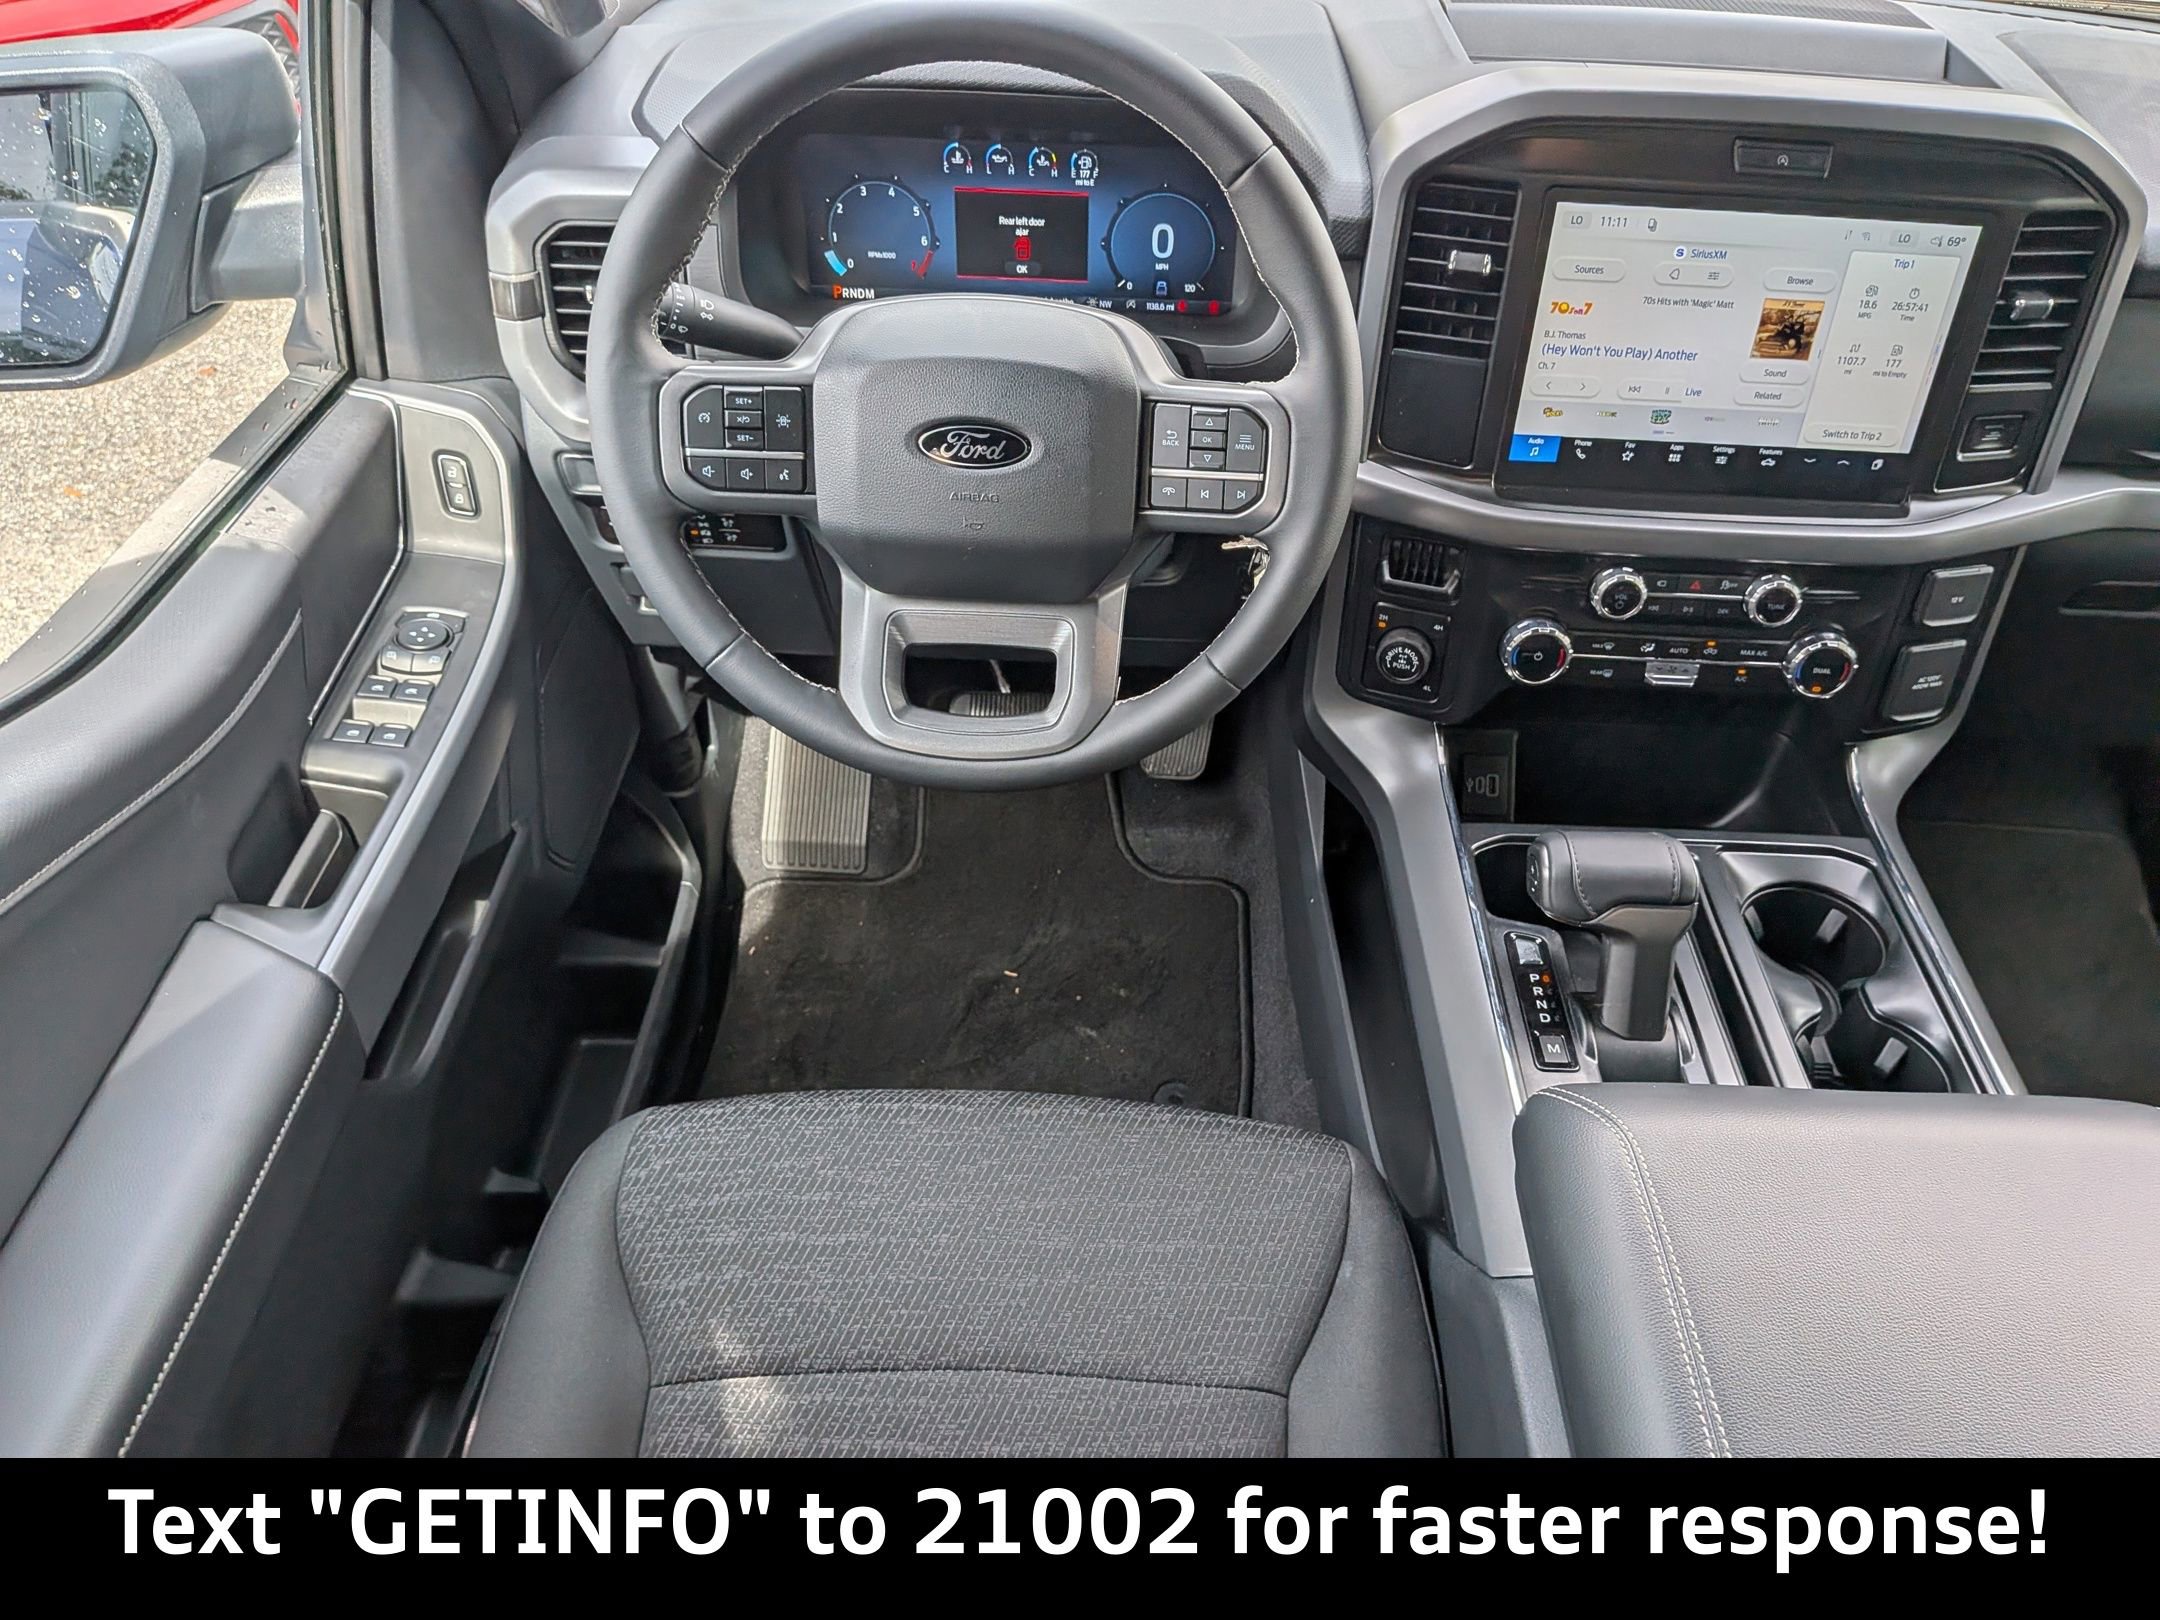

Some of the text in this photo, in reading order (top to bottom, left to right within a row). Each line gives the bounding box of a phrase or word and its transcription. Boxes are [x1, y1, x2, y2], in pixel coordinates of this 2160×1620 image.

[1080, 170, 1090, 178] 177
[860, 186, 866, 196] 3
[888, 187, 895, 197] 4
[837, 203, 843, 213] 2
[913, 206, 919, 216] 5
[999, 216, 1045, 226] Rear left door
[1571, 216, 1583, 225] LO
[1601, 217, 1628, 227] 11:11
[1016, 228, 1029, 236] ajar
[833, 232, 837, 242] 1
[921, 236, 928, 246] 6
[1152, 224, 1174, 258] 0
[1898, 234, 1910, 243] LO
[1691, 249, 1727, 260] SiriusXM
[847, 258, 854, 268] 0
[1894, 259, 1910, 269] Trip
[1016, 265, 1028, 273] OK
[1575, 265, 1604, 275] Sources
[1787, 276, 1813, 285] Browse
[1127, 282, 1132, 290] 0
[1185, 284, 1195, 292] 120
[1166, 303, 1174, 311] mi
[1643, 297, 1656, 305] 70s
[1657, 298, 1671, 306] Hits
[1673, 299, 1689, 307] with
[1717, 300, 1734, 309] Matt
[1859, 300, 1878, 309] 18.6
[1892, 302, 1928, 312] 26:57:41
[1900, 314, 1915, 322] Time
[1558, 331, 1586, 340] Thomas
[1542, 343, 1698, 361] (Hey Won't You Play) Another
[1838, 357, 1866, 366] 1107.7
[1886, 360, 1902, 368] 177
[1764, 369, 1787, 377] Sound
[1888, 371, 1907, 379] Empty
[1685, 388, 1702, 397] Live
[1754, 392, 1782, 400] Related
[1823, 430, 1882, 441] Switch to Trip 2
[940, 431, 1006, 459] Ford
[1528, 437, 1544, 445] Audio
[1574, 439, 1592, 447] Phone
[1713, 445, 1735, 454] Settings
[1759, 448, 1783, 456] Features
[949, 492, 1000, 502] AIRBAG
[1385, 647, 1402, 661] DRIVE
[1530, 974, 1540, 982] P
[1533, 986, 1544, 996] R
[1536, 1000, 1547, 1009] N
[1539, 1013, 1550, 1023] D
[1546, 1043, 1561, 1053] M
